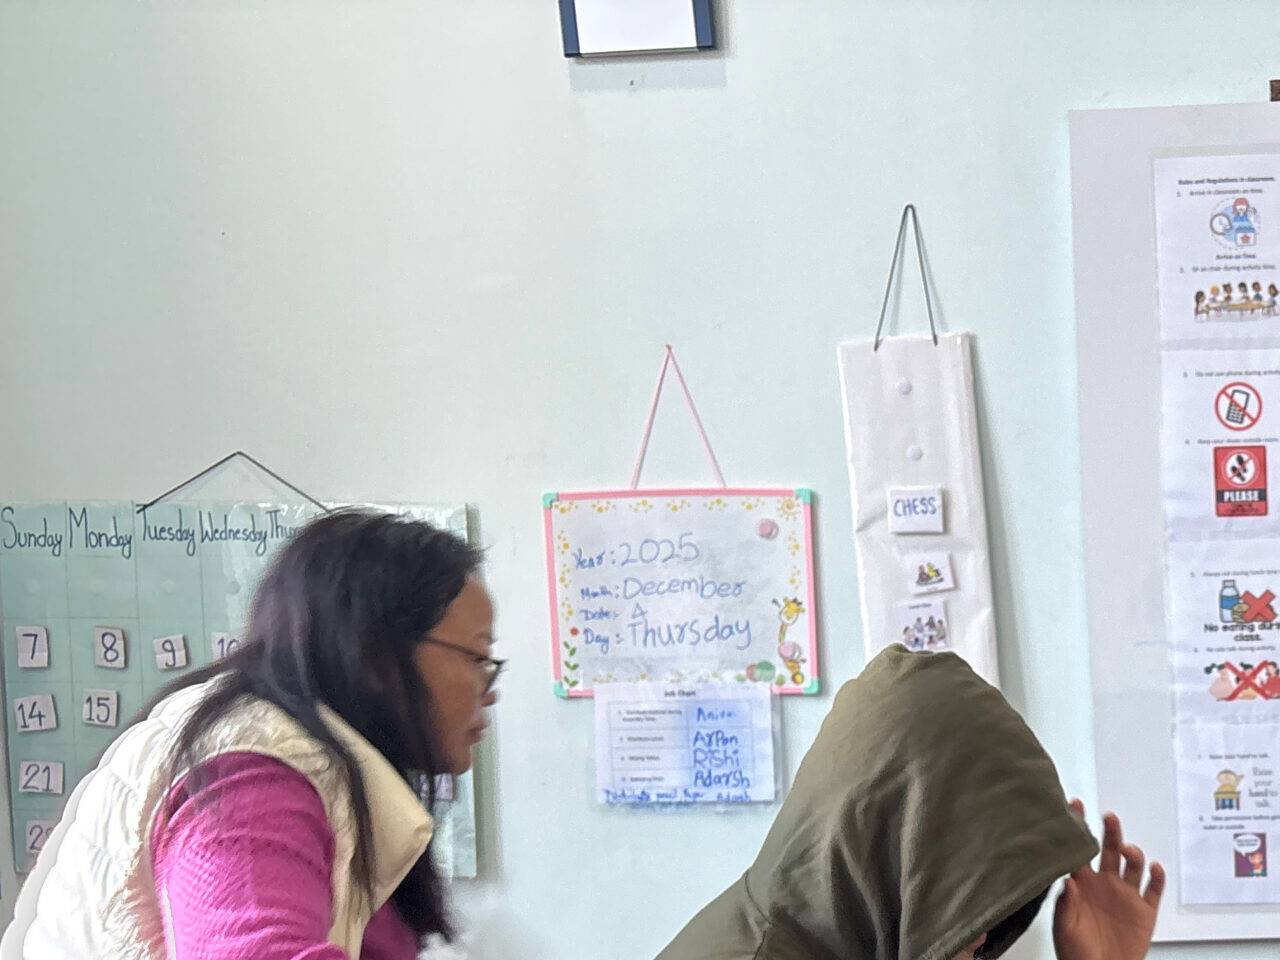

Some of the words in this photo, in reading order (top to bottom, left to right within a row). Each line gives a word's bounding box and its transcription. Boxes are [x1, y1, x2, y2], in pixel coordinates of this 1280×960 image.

[893, 496, 937, 517] CHESS
[1223, 489, 1259, 502] PLEASE
[1, 507, 62, 557] Sunday
[69, 507, 132, 559] Monday
[136, 503, 195, 556] Tuesday
[200, 510, 268, 556] Wednesday
[619, 532, 701, 567] 2025
[623, 576, 747, 600] December
[627, 614, 752, 651] Thursday
[22, 633, 38, 660] 7
[101, 632, 119, 662] 8
[161, 639, 178, 667] 9
[17, 701, 46, 729] 14
[85, 696, 111, 723] 15
[22, 763, 54, 792] 21
